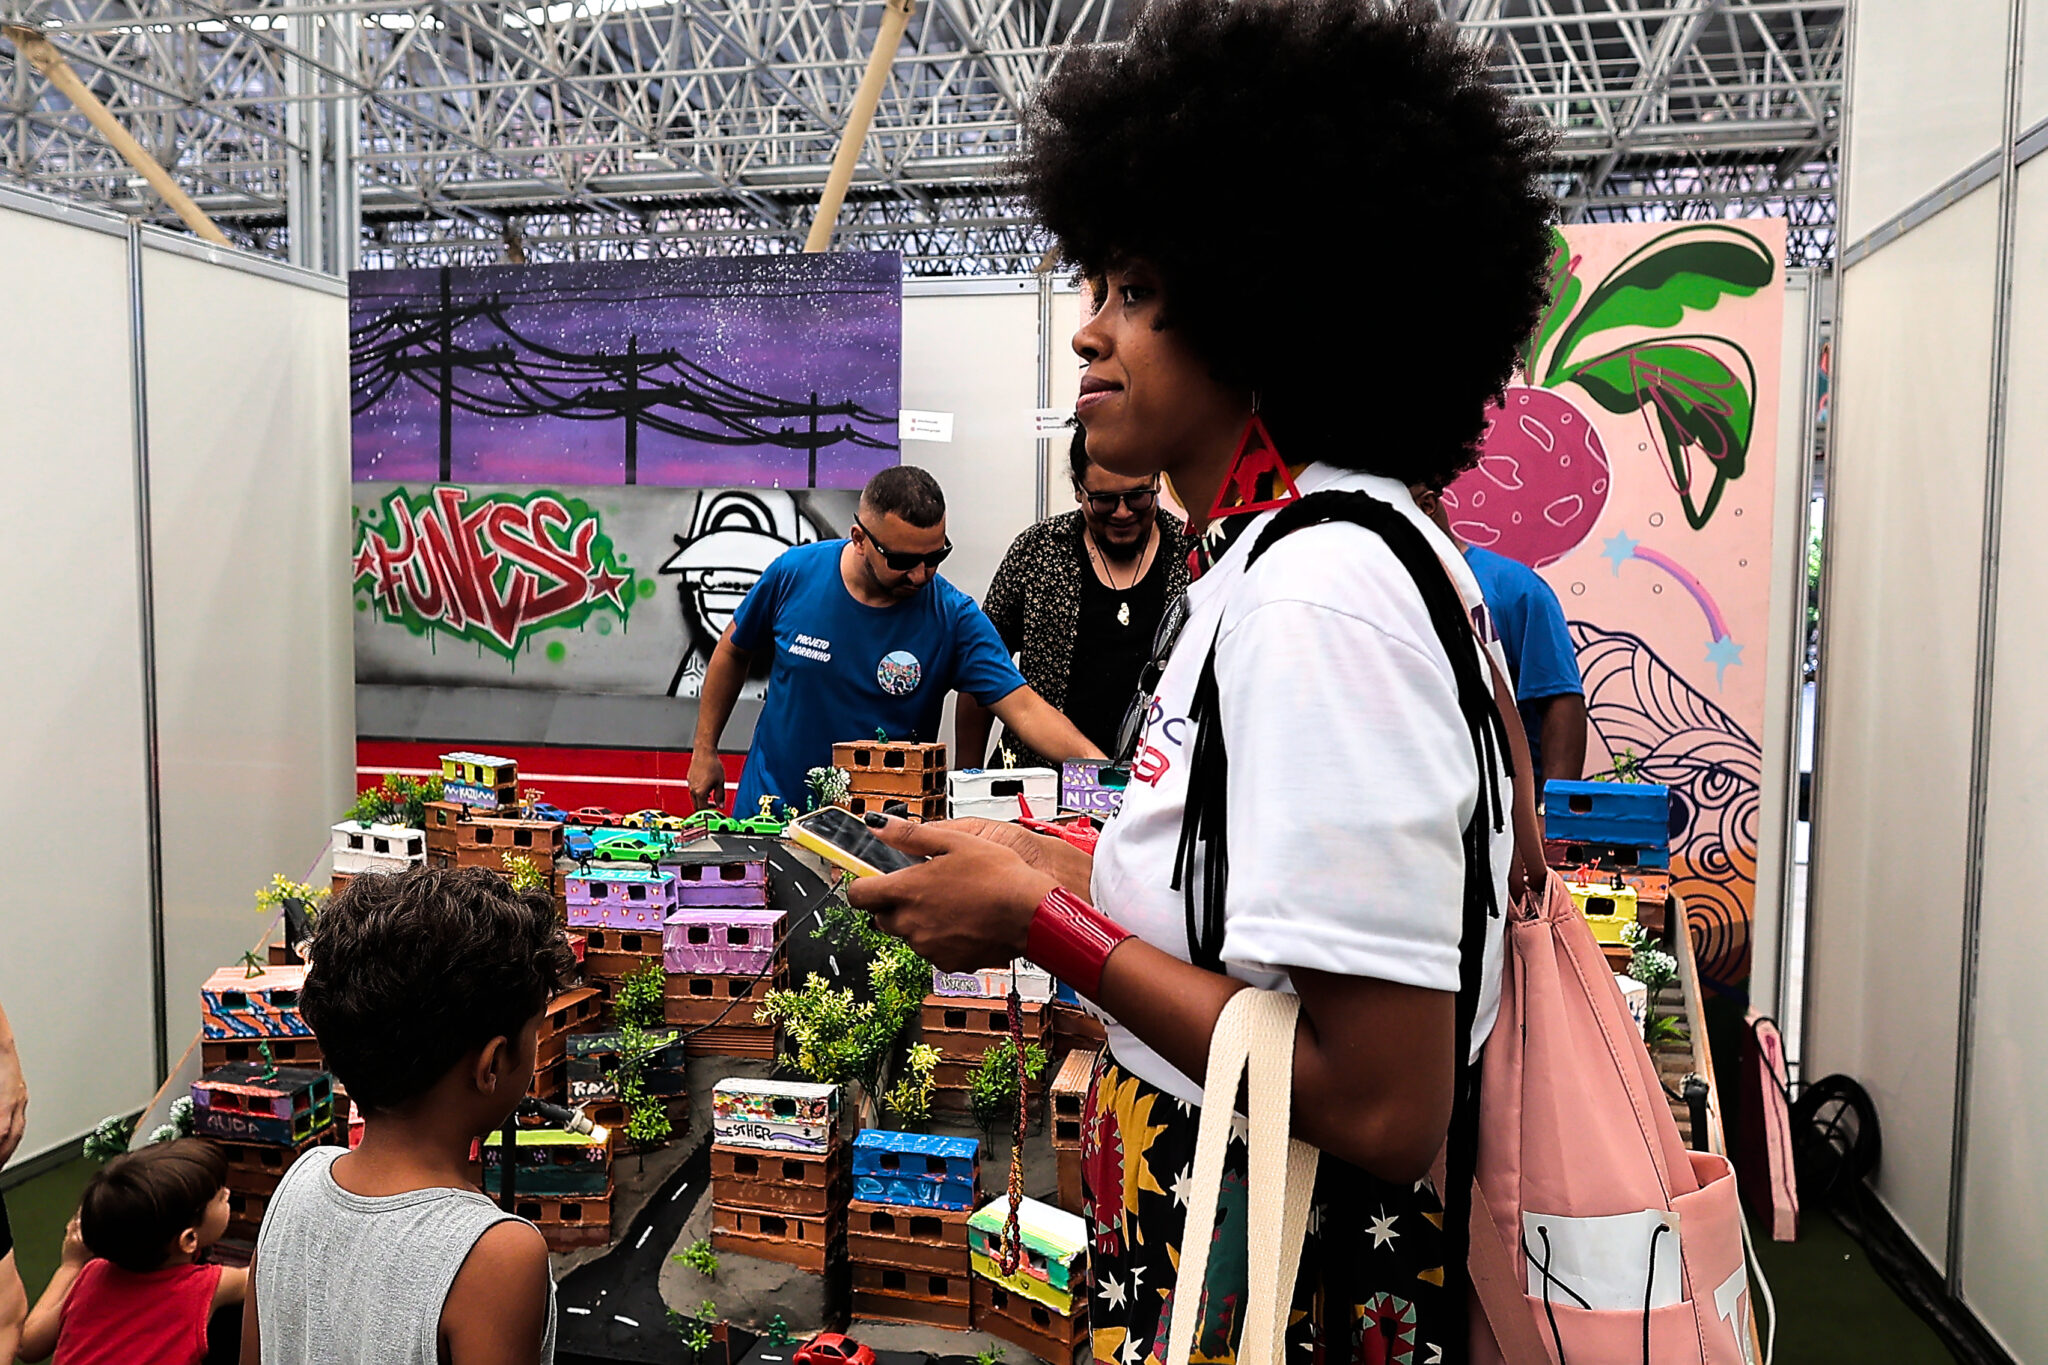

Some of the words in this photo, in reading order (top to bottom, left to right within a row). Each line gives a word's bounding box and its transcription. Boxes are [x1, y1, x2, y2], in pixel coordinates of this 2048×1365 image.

[795, 633, 830, 650] PROJETO
[788, 643, 831, 663] MORRINHO
[726, 1124, 773, 1141] ESTHER
